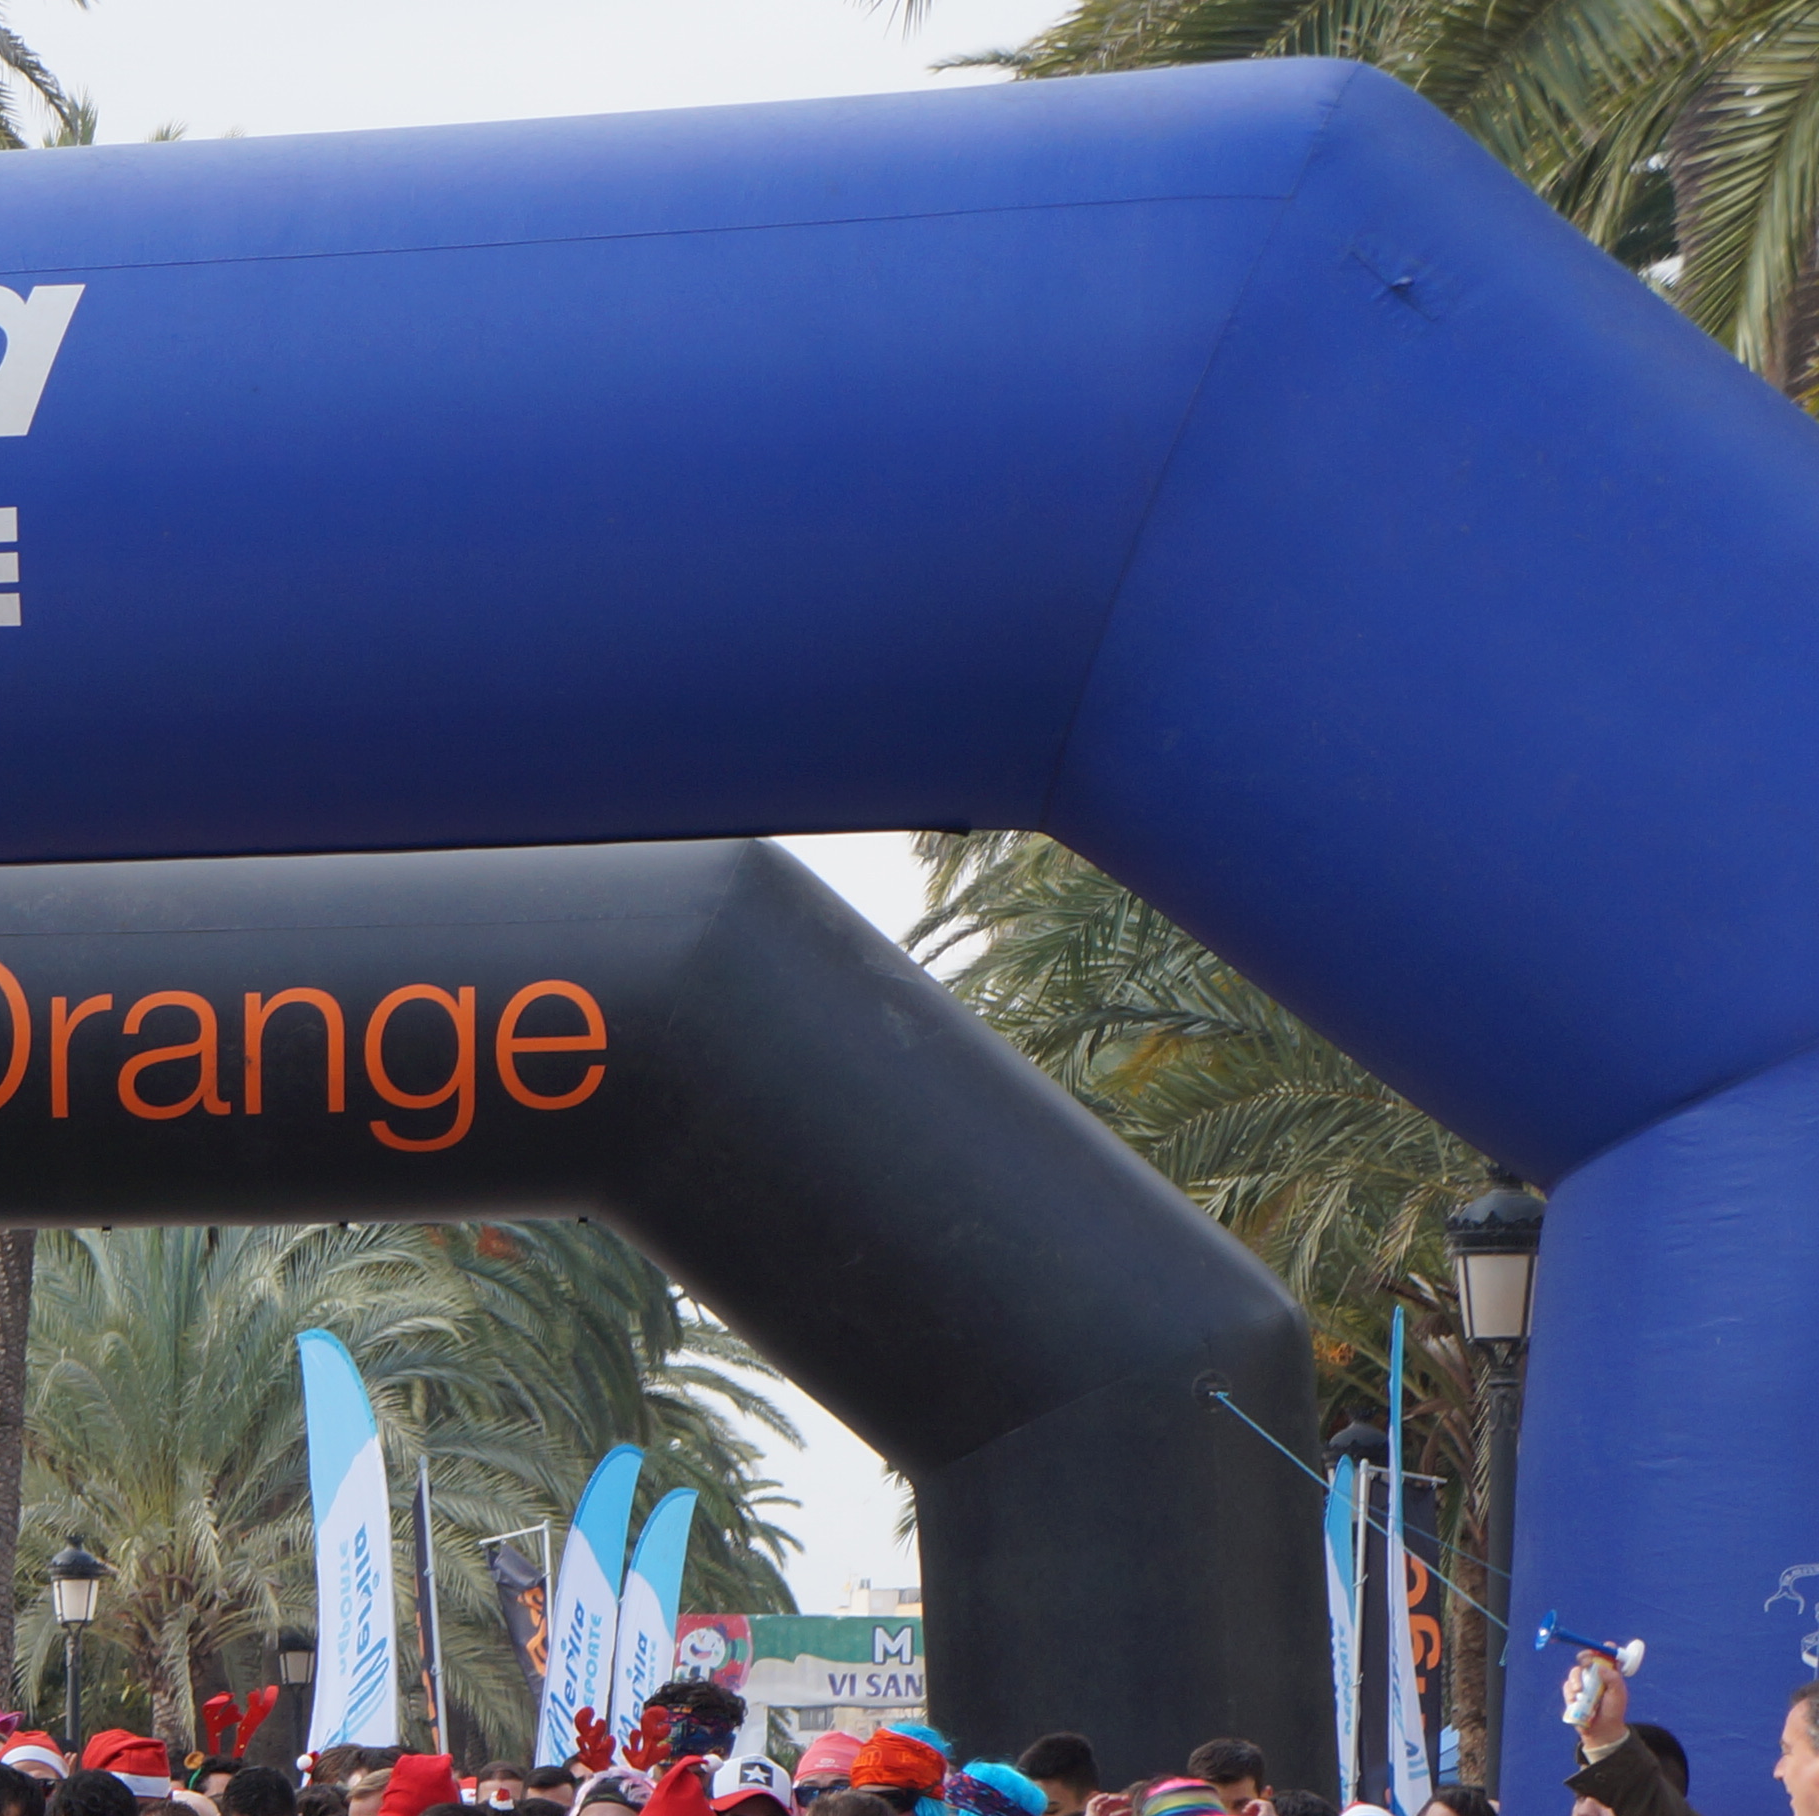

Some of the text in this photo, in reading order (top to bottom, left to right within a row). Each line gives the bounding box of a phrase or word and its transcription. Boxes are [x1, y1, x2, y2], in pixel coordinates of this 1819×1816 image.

[584, 1612, 603, 1706] EPORTE
[828, 1672, 923, 1697] VI SAN
